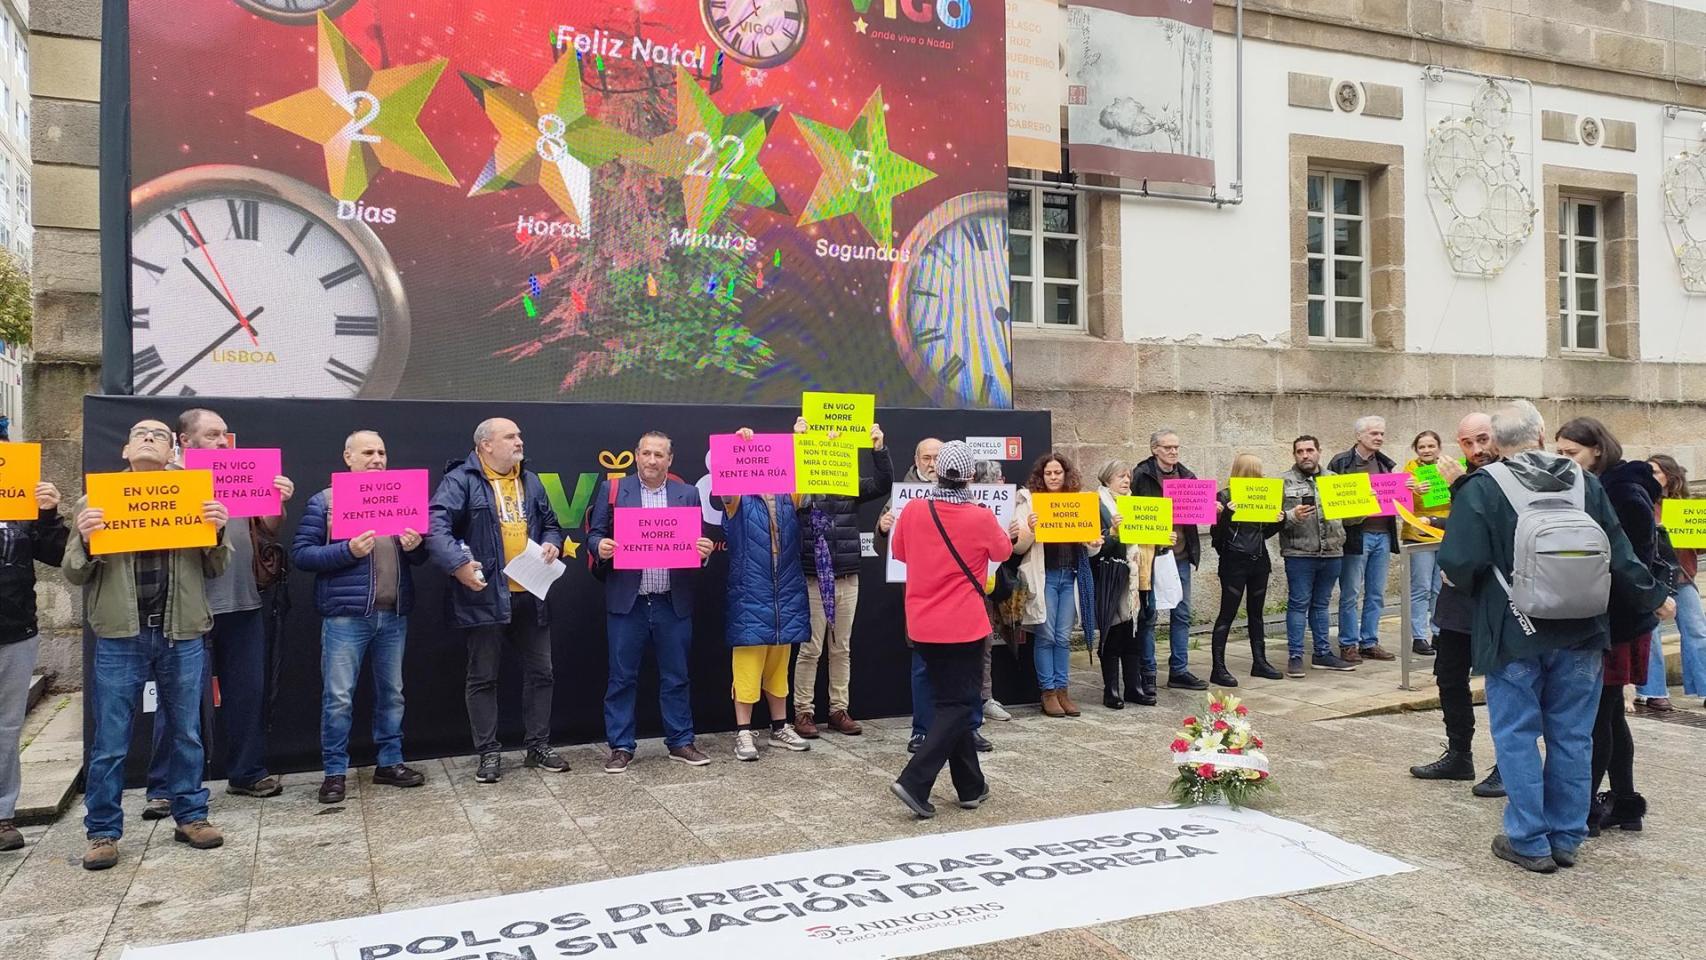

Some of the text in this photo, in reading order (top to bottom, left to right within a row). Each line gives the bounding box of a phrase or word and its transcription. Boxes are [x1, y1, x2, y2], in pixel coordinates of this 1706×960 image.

[740, 22, 774, 36] VIGO
[871, 30, 896, 40] onde
[898, 34, 917, 44] vive
[918, 37, 925, 45] o
[555, 25, 707, 69] Feliz Natal
[343, 90, 382, 143] 2
[536, 114, 568, 161] 8
[685, 131, 746, 181] 22
[851, 150, 876, 193] 5
[337, 200, 397, 225] Dias
[516, 215, 590, 240] Horas
[669, 227, 757, 252] Minutos
[815, 238, 911, 263] Segundos
[211, 350, 277, 364] LISBOA
[823, 402, 855, 411] EN VIGO
[825, 413, 852, 421] MORRE
[809, 424, 834, 432] XENTE
[850, 423, 866, 433] RÚA
[733, 444, 772, 453] EN VIGO
[212, 461, 256, 471] EN VIGO
[736, 456, 769, 465] MORRE
[719, 466, 787, 478] XENTE NA RÚA
[215, 474, 254, 485] MORRE
[123, 484, 180, 498] EN VIGO
[231, 489, 248, 498] NA
[250, 486, 272, 498] RÚA
[360, 482, 401, 493] EN VIGO
[362, 495, 399, 505] MORRE
[973, 489, 989, 500] UE
[992, 490, 1009, 501] AS
[128, 500, 177, 513] MORRE
[343, 506, 418, 520] XENTE NA RÚA
[103, 512, 202, 530] XENTE NA RÚA
[638, 518, 678, 527] EN VIGO
[1039, 521, 1064, 529] XENTE
[1078, 520, 1093, 528] RÚA
[1156, 523, 1169, 531] RÚA
[641, 531, 676, 539] MORRE
[622, 540, 692, 552] XENTE NA RÚA
[360, 823, 1220, 960] POLOS DEREITOS DAS PERSOAS
[555, 889, 894, 957] SITUACIÓN
[896, 877, 980, 899] DE
[979, 844, 1218, 887] POBREZA
[856, 901, 1005, 932] NINGUÉNS
[835, 913, 999, 945] FORO SOCIOEDUCATIVO
